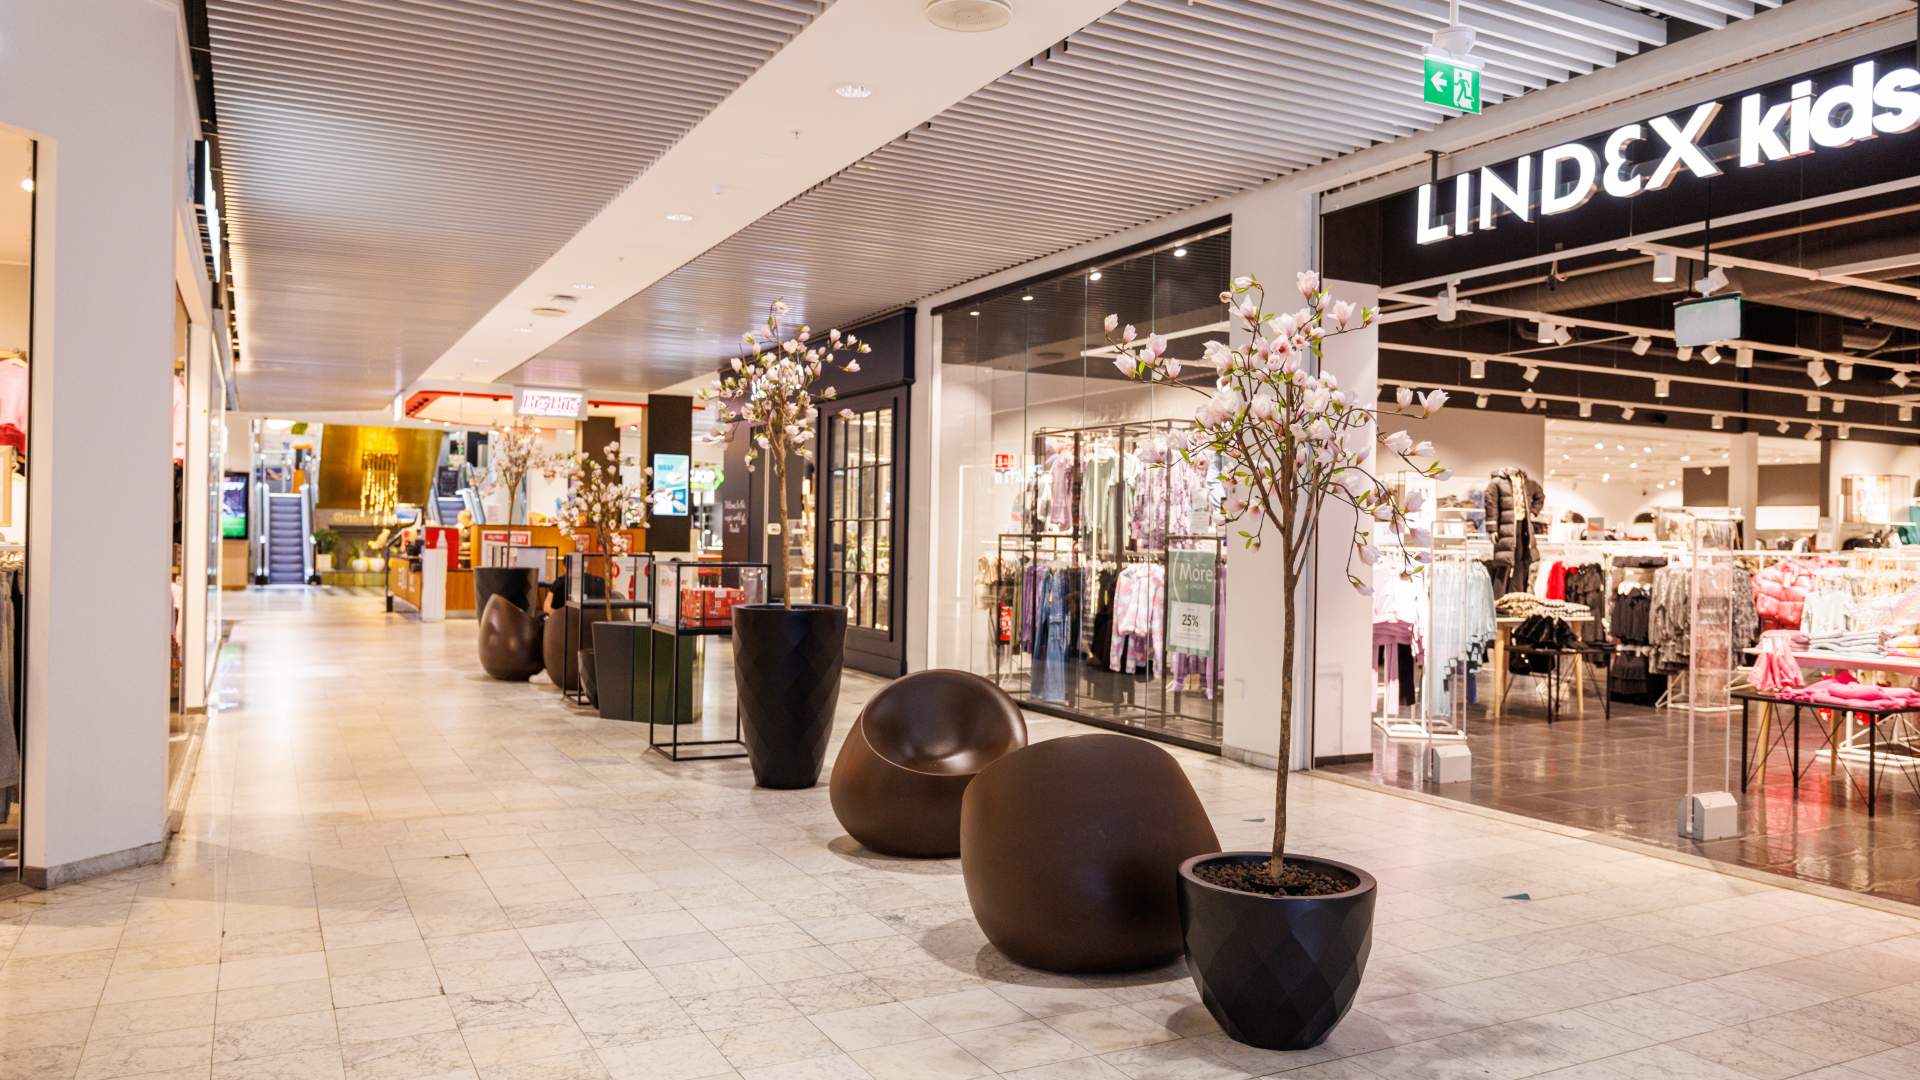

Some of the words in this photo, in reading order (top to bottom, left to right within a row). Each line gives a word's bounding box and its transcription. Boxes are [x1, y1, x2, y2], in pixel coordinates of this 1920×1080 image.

[1740, 60, 1920, 168] kids
[1179, 562, 1214, 583] More
[1181, 613, 1199, 628] 25%
